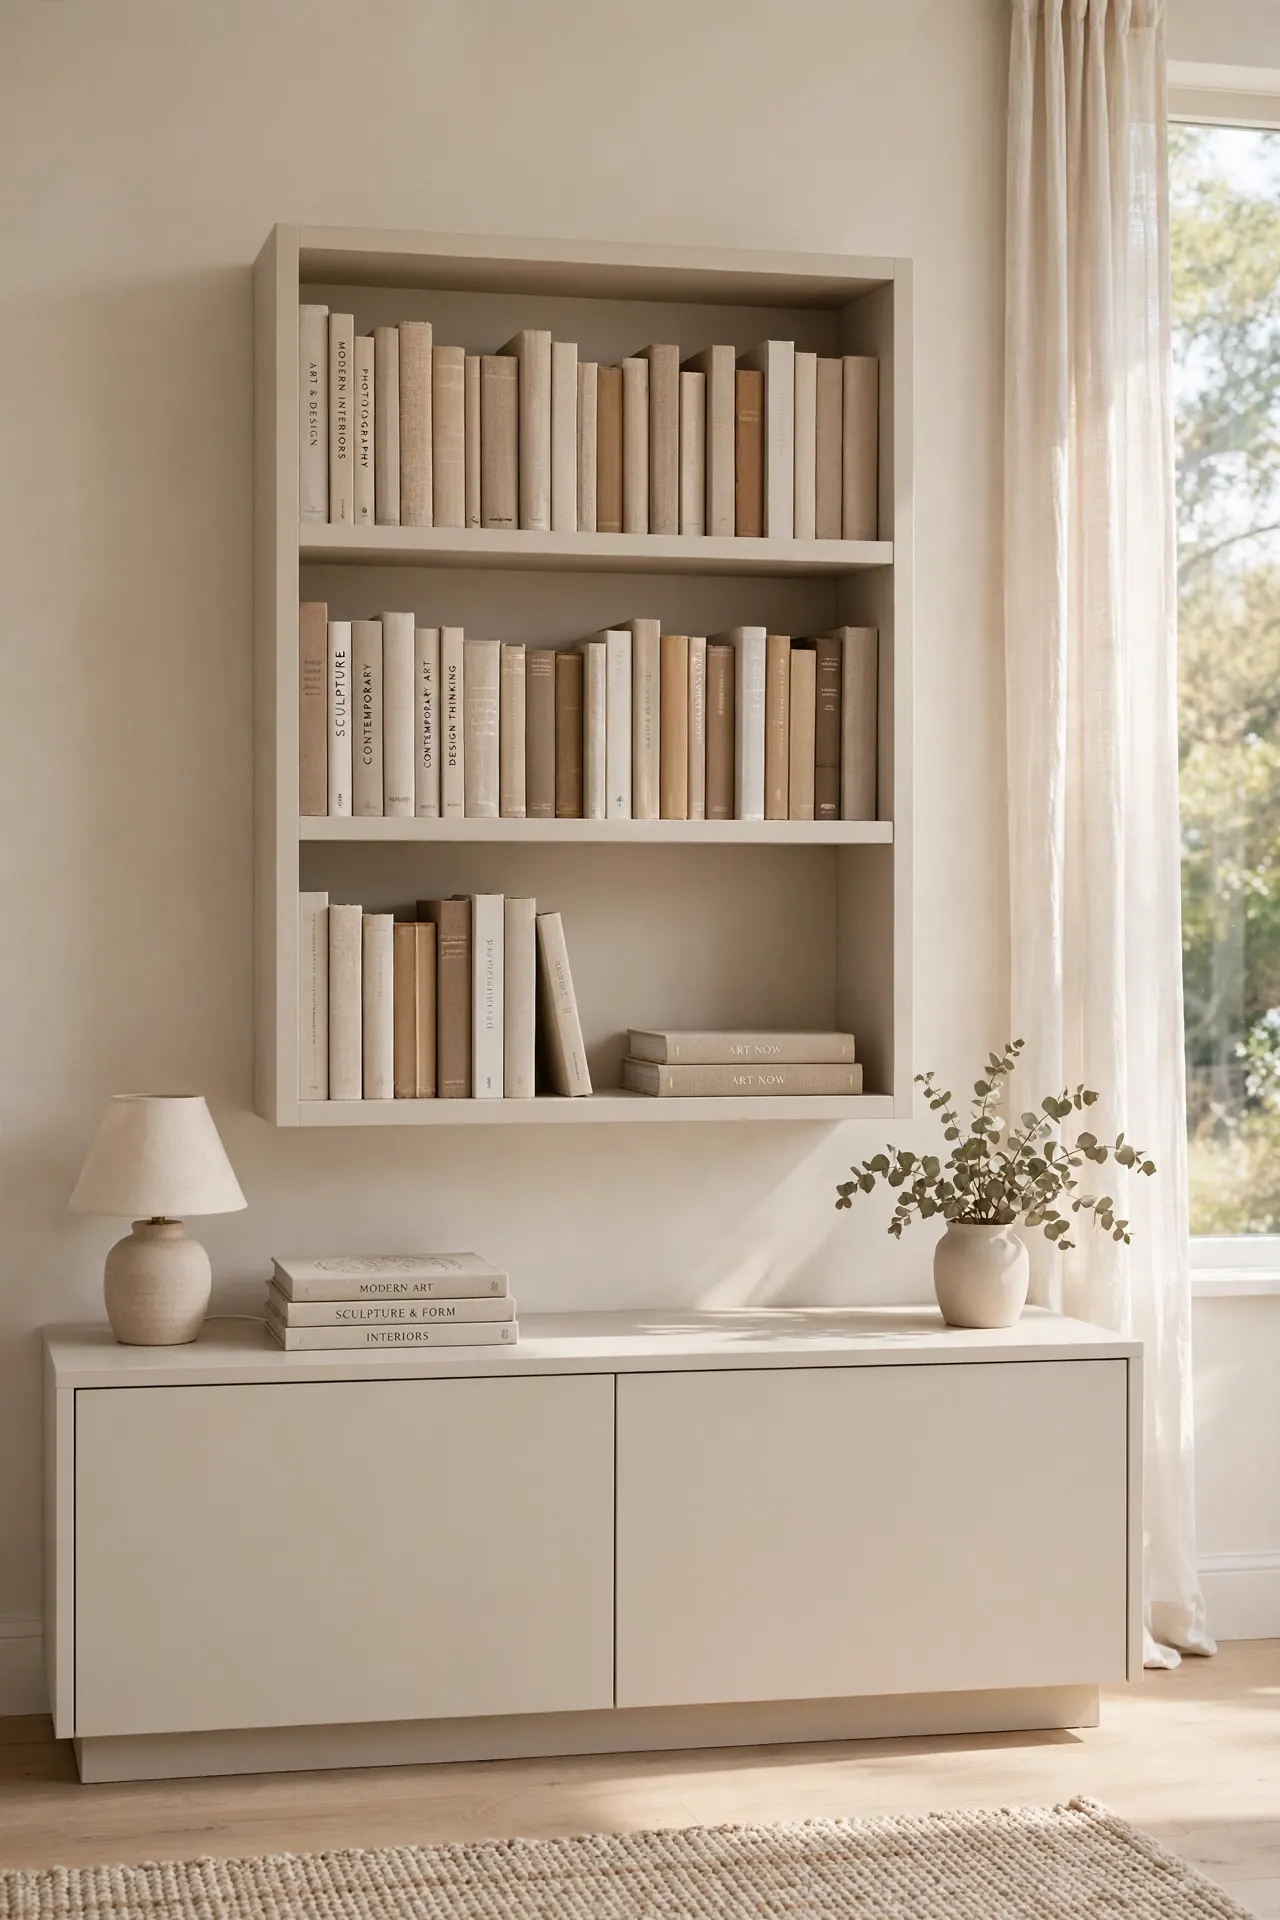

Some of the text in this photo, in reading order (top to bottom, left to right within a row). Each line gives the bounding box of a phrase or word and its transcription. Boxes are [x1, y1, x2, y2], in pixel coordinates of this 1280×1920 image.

[309, 363, 318, 384] ART
[338, 341, 346, 460] MODERN INTERIORS
[309, 402, 318, 446] DESIGN
[335, 651, 346, 737] SCULPTURE
[363, 663, 372, 765] CONTEMPORARY
[423, 660, 432, 768] CONTEMPORARY ART
[449, 665, 457, 766] DESIGN THINKING
[729, 1045, 780, 1054] ART NOW
[731, 1076, 786, 1085] ART NOW
[359, 1282, 434, 1293] MODERN ART
[335, 1307, 456, 1319] SCULPTURE & FORM
[366, 1331, 429, 1342] INTERIORS
